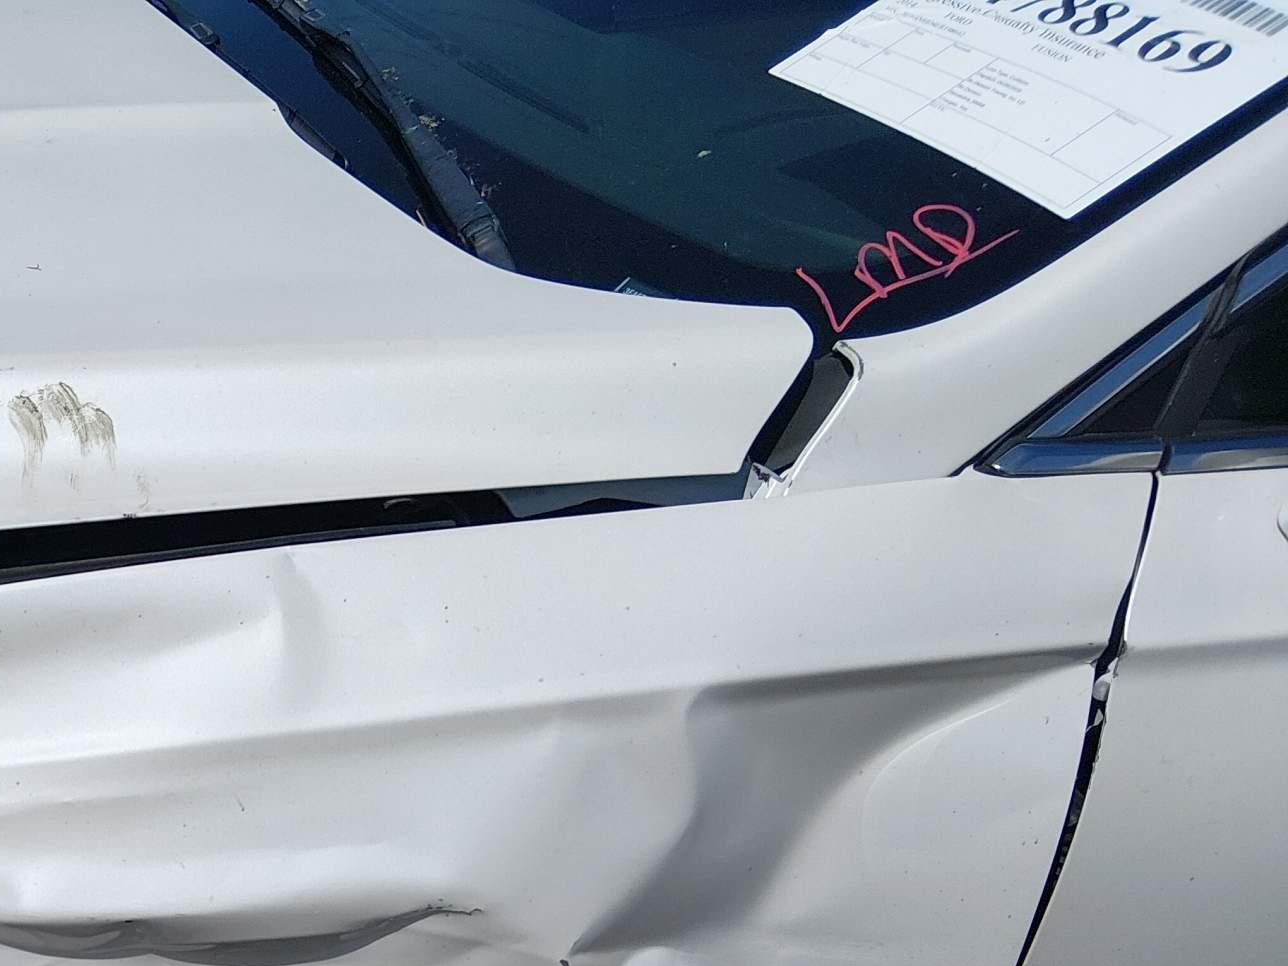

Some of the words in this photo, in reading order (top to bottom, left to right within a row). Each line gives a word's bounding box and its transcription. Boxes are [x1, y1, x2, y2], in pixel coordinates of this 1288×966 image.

[943, 11, 974, 25] FORD
[1030, 42, 1073, 63] FUSION
[1038, 27, 1107, 60] Insurance
